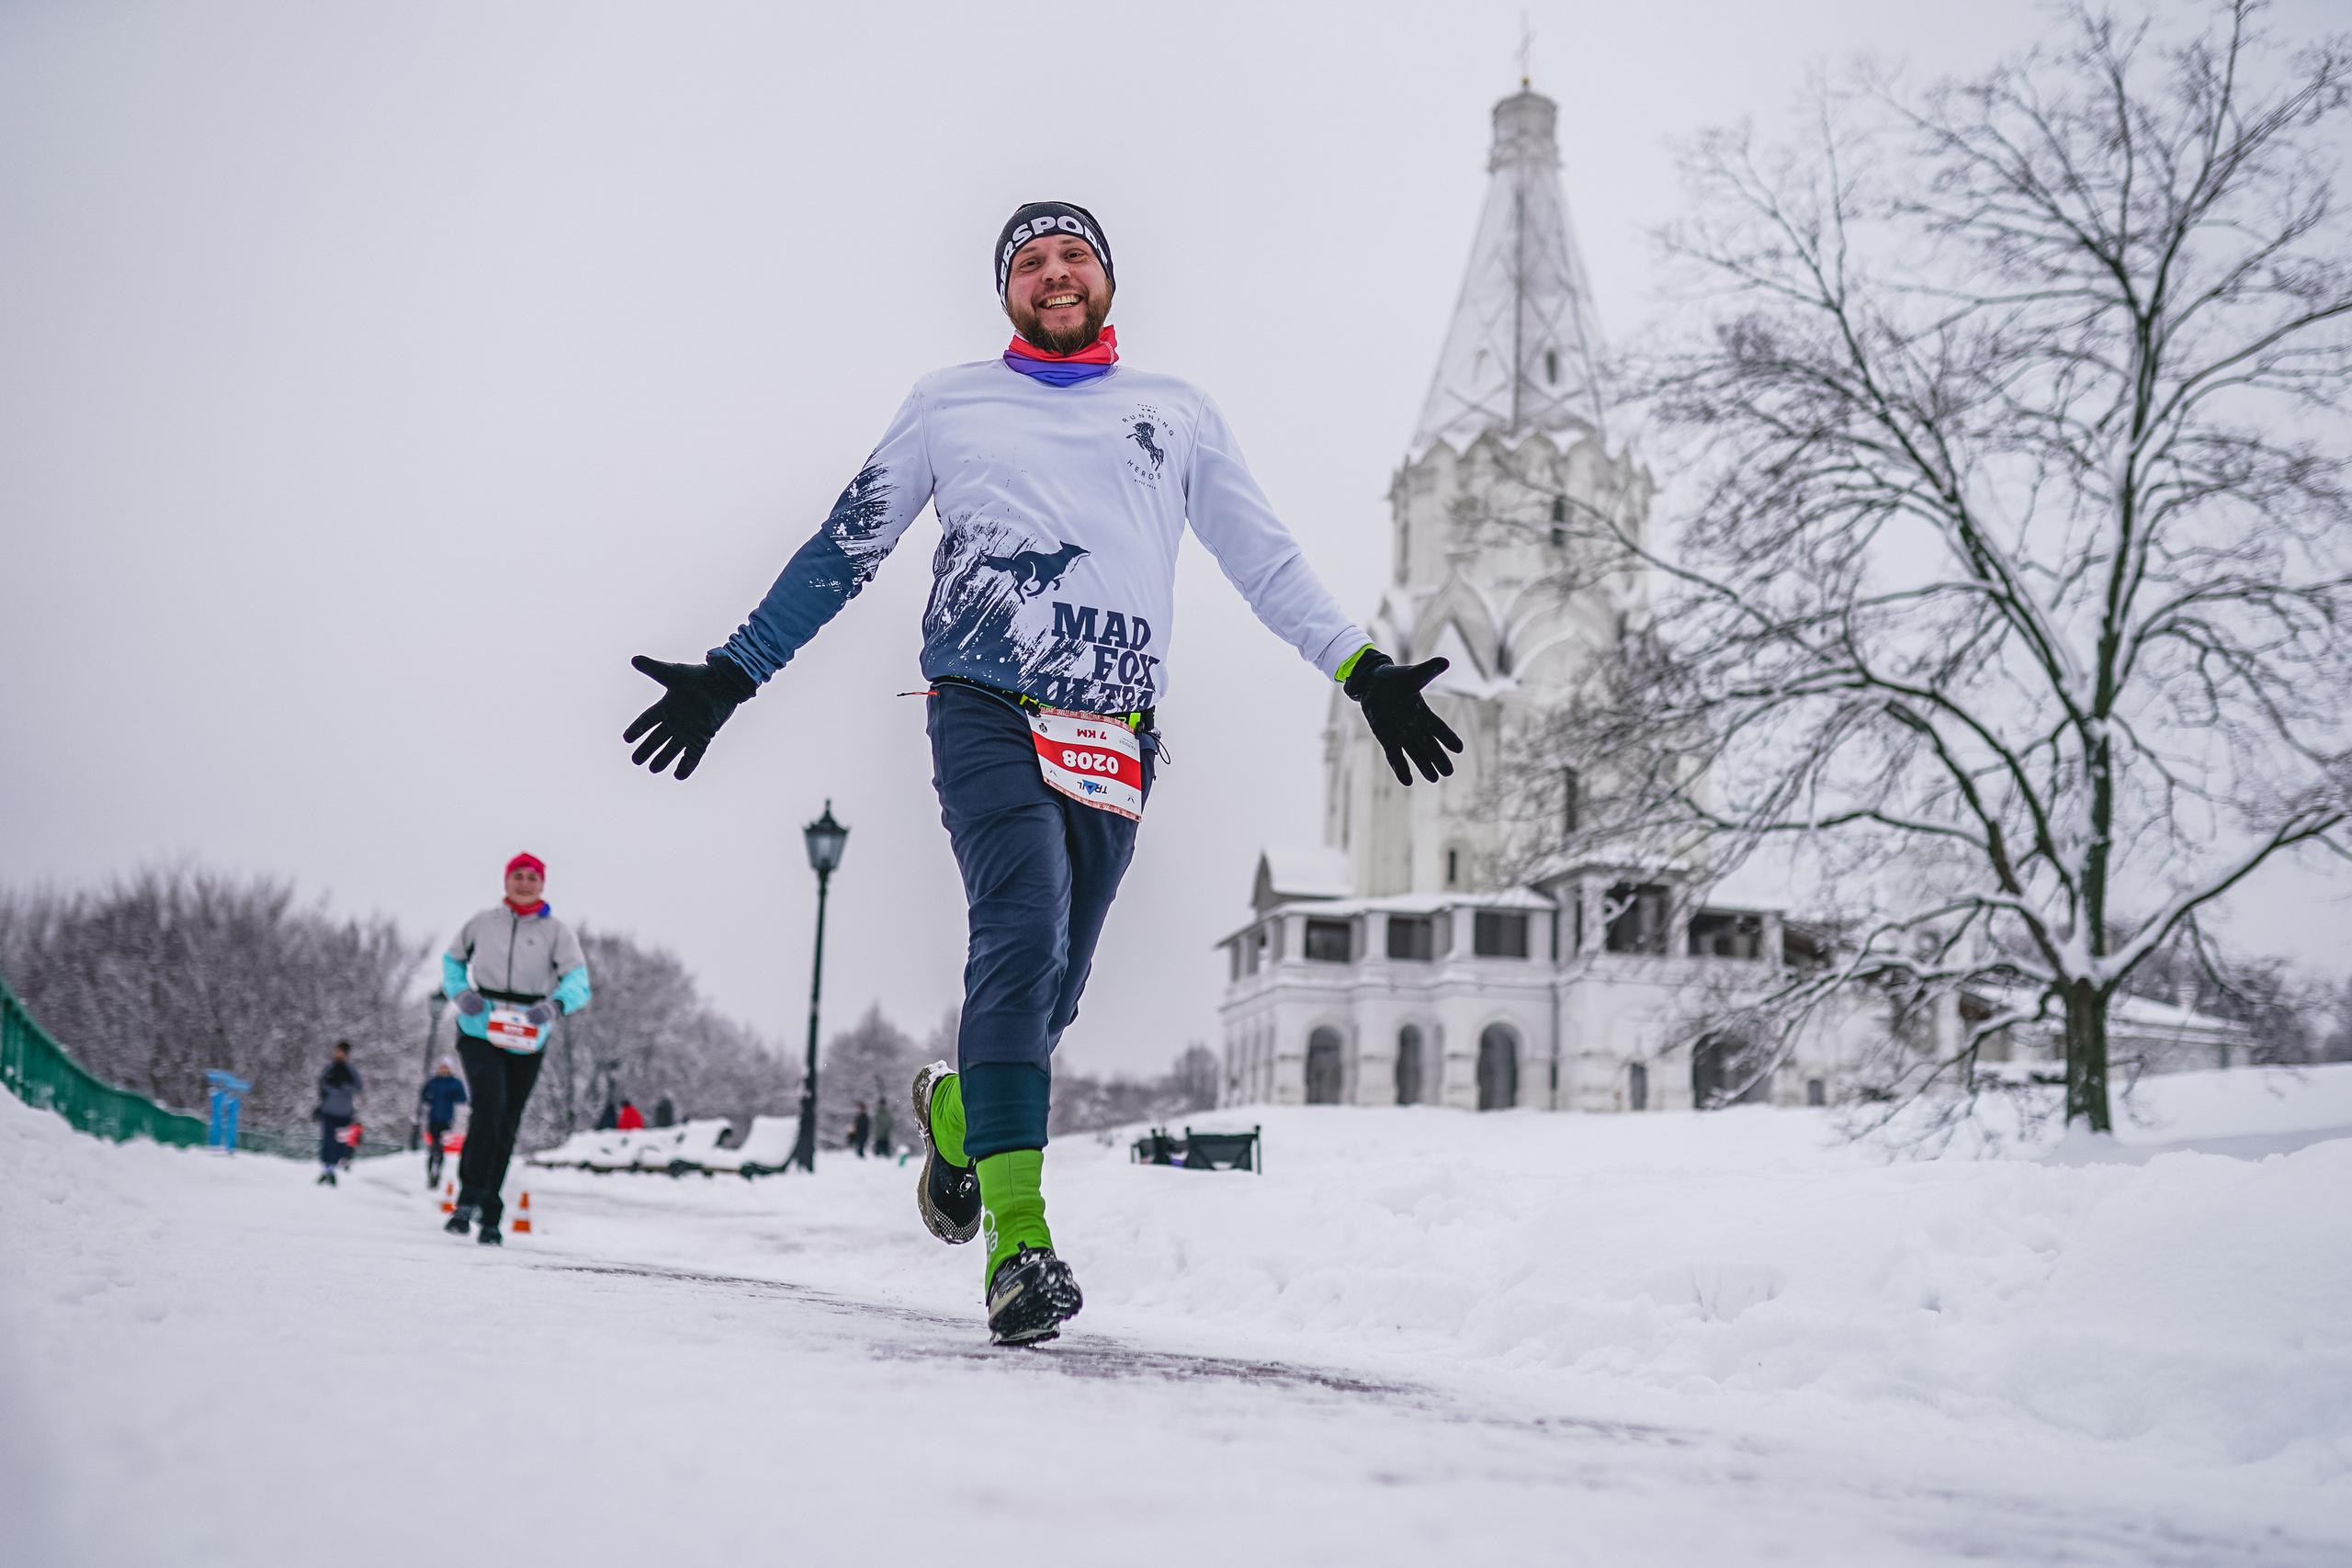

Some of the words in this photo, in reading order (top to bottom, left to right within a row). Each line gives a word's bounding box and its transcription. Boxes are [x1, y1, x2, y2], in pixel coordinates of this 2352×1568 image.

[1122, 413, 1174, 436] RUNNING
[1126, 459, 1161, 479] HEROS
[1051, 602, 1152, 651] MAD
[1091, 645, 1160, 692] FOX
[1077, 728, 1096, 739] KM
[1100, 731, 1107, 740] 7
[1061, 750, 1119, 774] 0208
[1077, 779, 1108, 795] TRAIL
